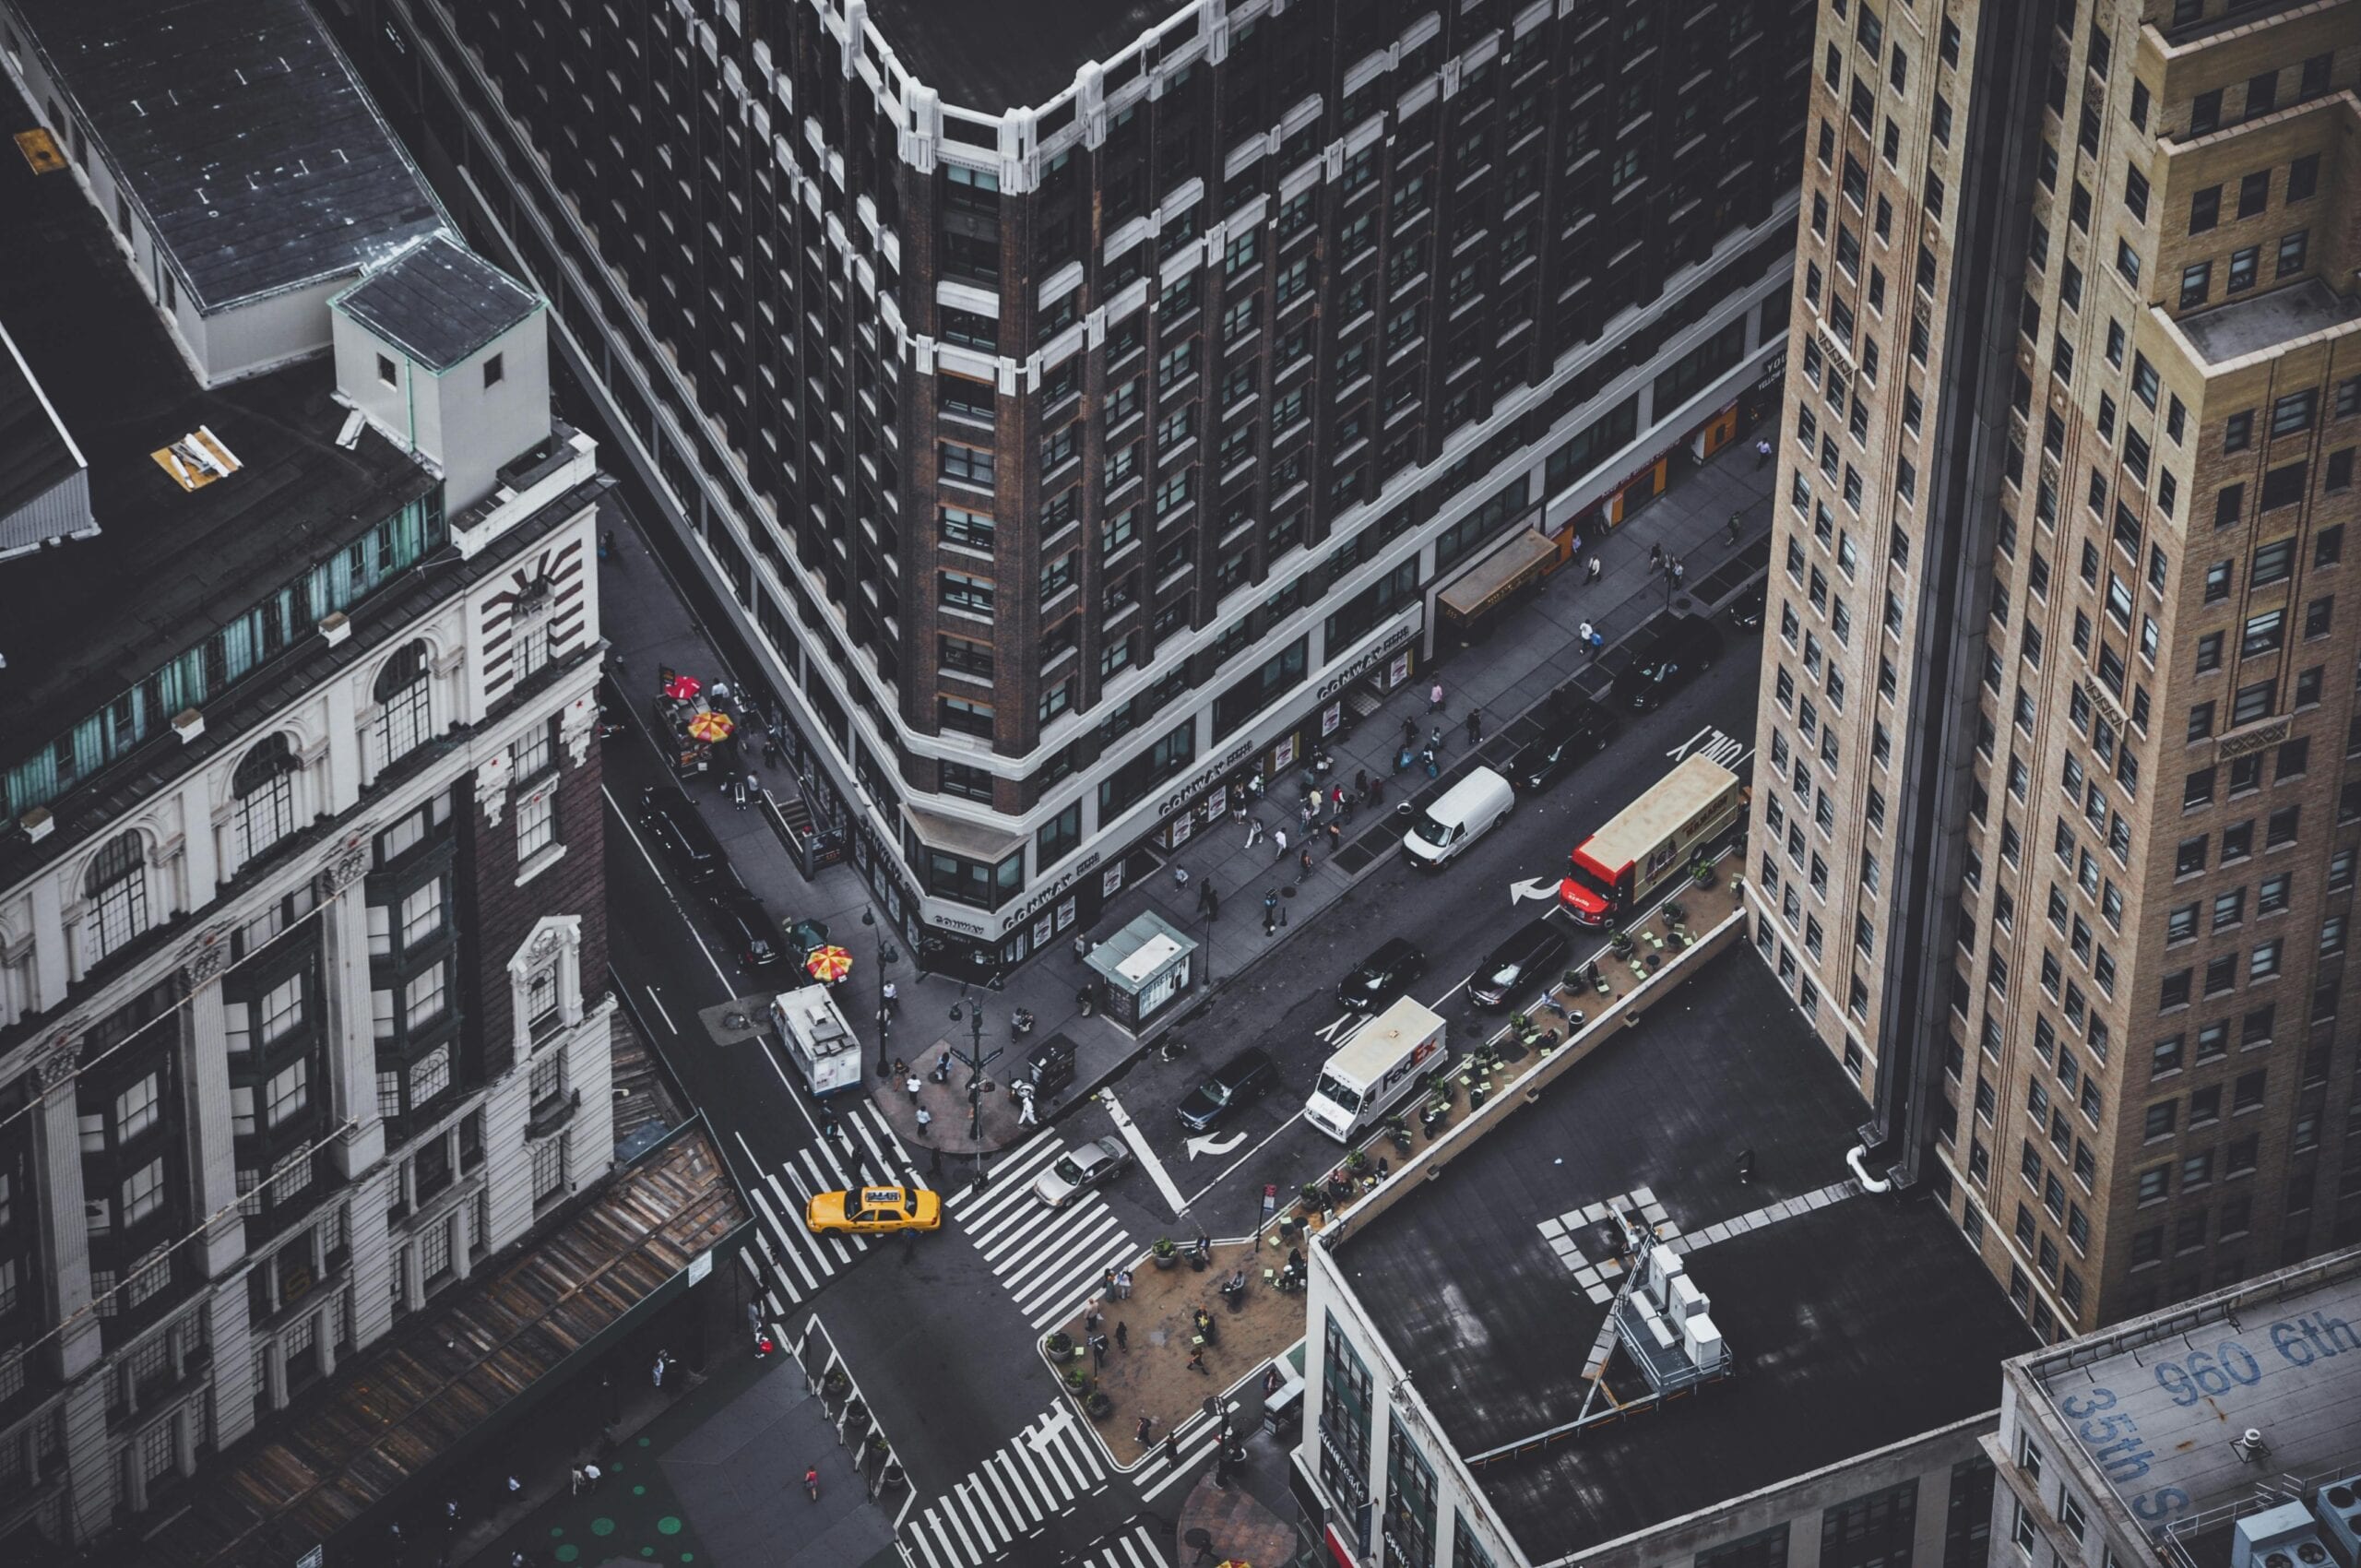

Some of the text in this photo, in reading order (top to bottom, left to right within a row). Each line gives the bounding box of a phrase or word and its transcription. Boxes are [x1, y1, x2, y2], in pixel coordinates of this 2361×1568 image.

[1317, 646, 1382, 701] CONWAY
[1158, 760, 1225, 816] CONWAY
[933, 915, 984, 933] CONWAY
[1003, 873, 1073, 931] CONWAY
[1382, 1038, 1438, 1092] FedEx
[2153, 1311, 2361, 1408] 960 6th
[2062, 1387, 2156, 1484] 35th
